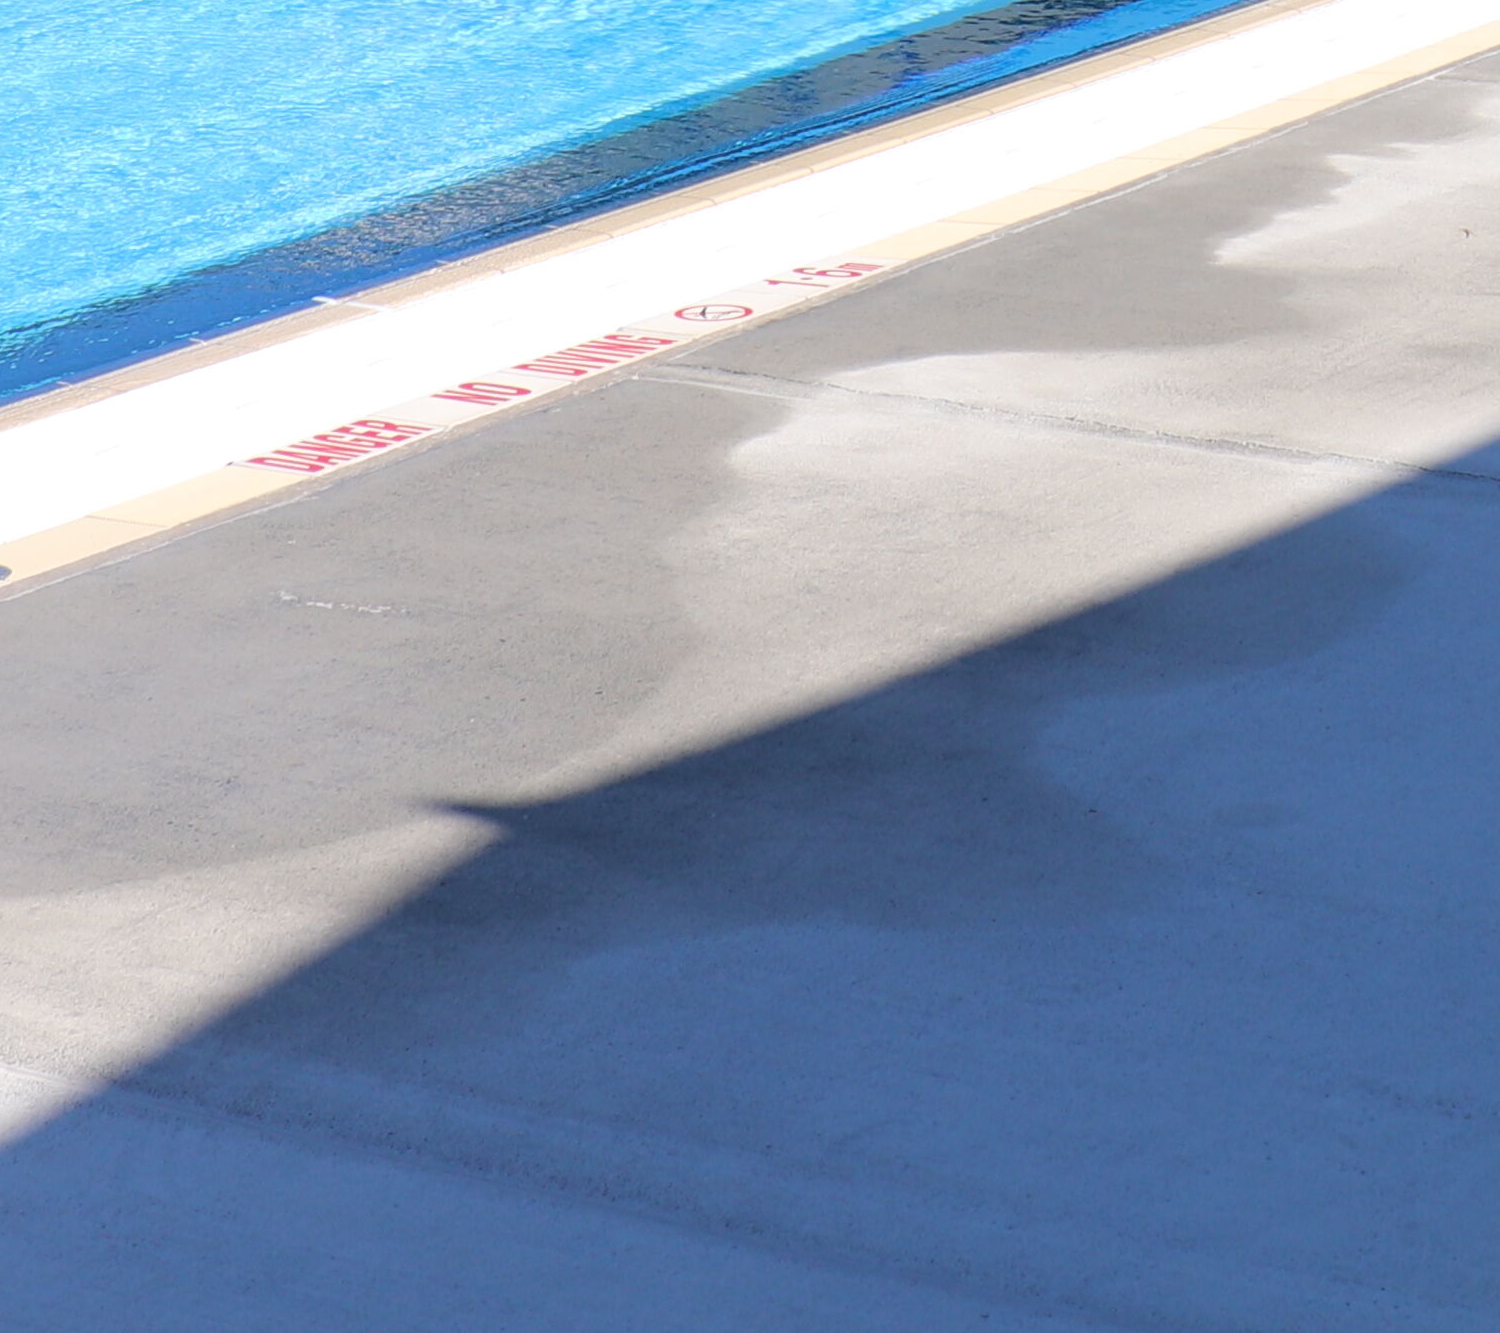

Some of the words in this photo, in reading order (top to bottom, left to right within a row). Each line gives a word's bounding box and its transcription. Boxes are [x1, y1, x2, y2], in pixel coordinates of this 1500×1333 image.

[248, 418, 434, 474] DANGER
[431, 381, 533, 407] NO
[512, 333, 675, 378] DIVING
